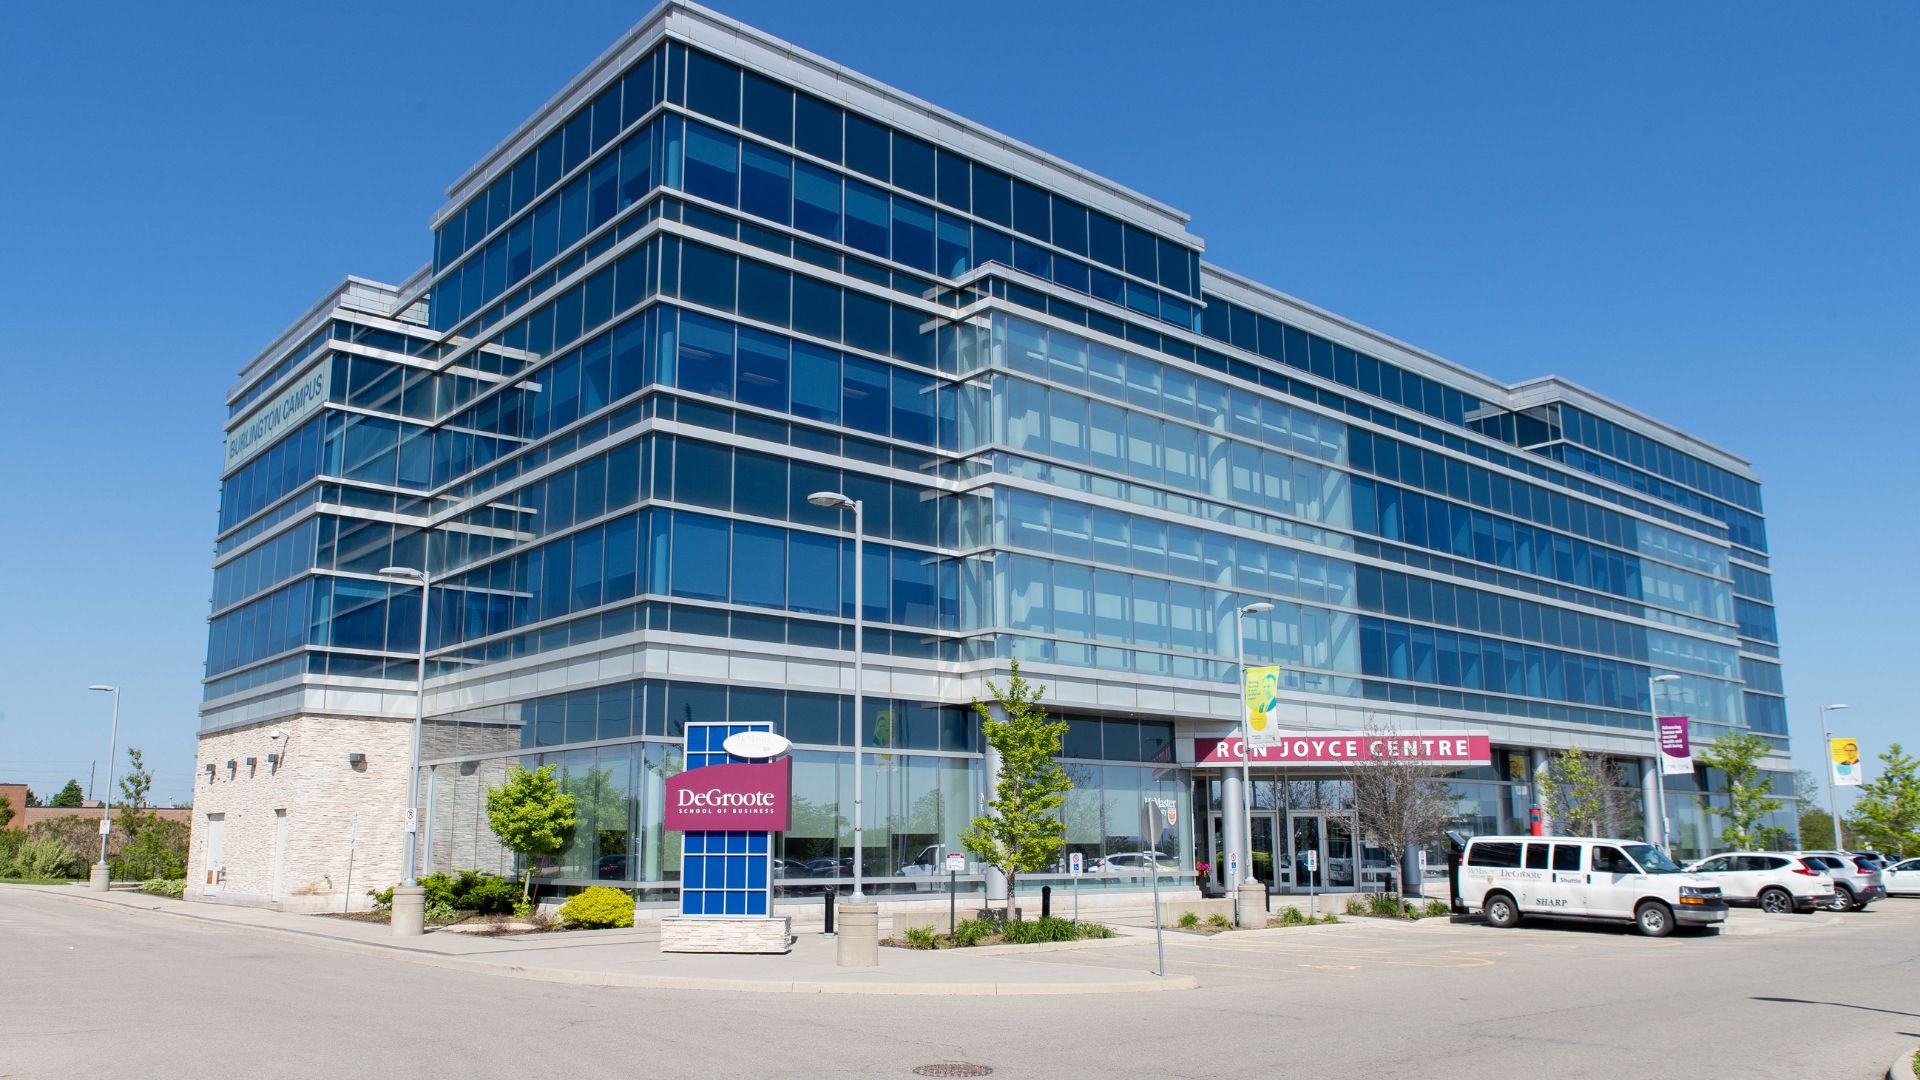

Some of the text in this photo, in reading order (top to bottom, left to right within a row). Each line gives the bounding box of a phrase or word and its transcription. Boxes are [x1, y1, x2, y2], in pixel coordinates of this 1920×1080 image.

[229, 374, 322, 458] BURLINGTON CAMPUS
[1217, 740, 1468, 757] RON JOYCE CENTRE
[678, 788, 775, 806] DeGroote
[1500, 868, 1542, 879] DeGroote
[1536, 898, 1567, 907] SHARP
